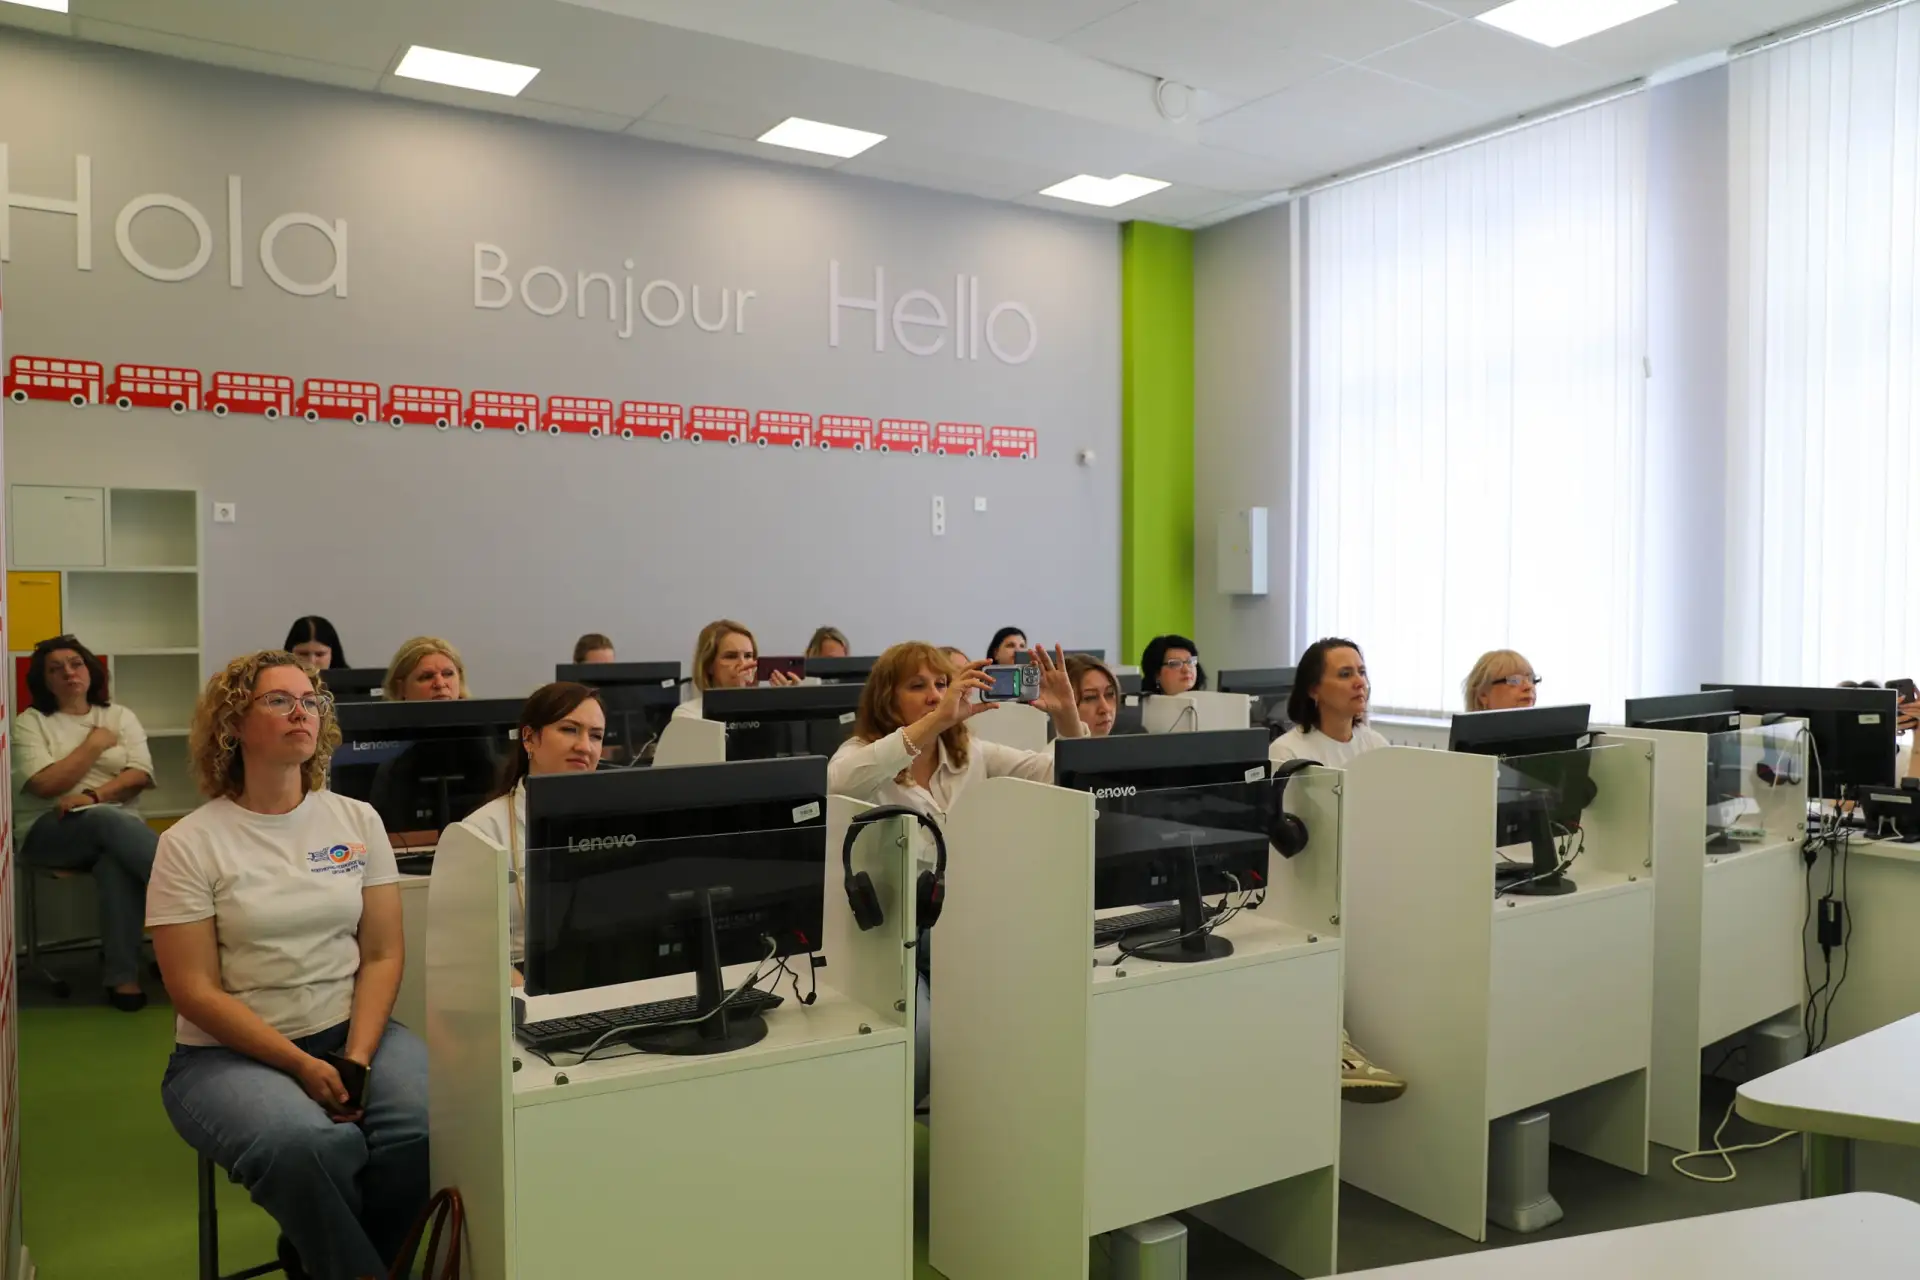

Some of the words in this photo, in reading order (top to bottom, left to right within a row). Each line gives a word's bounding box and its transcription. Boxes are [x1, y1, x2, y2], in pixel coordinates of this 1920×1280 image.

[0, 143, 347, 298] Hola
[473, 241, 756, 339] Bonjour
[829, 259, 1037, 364] Hello
[353, 740, 399, 751] Lenovo
[568, 833, 637, 853] Lenovo
